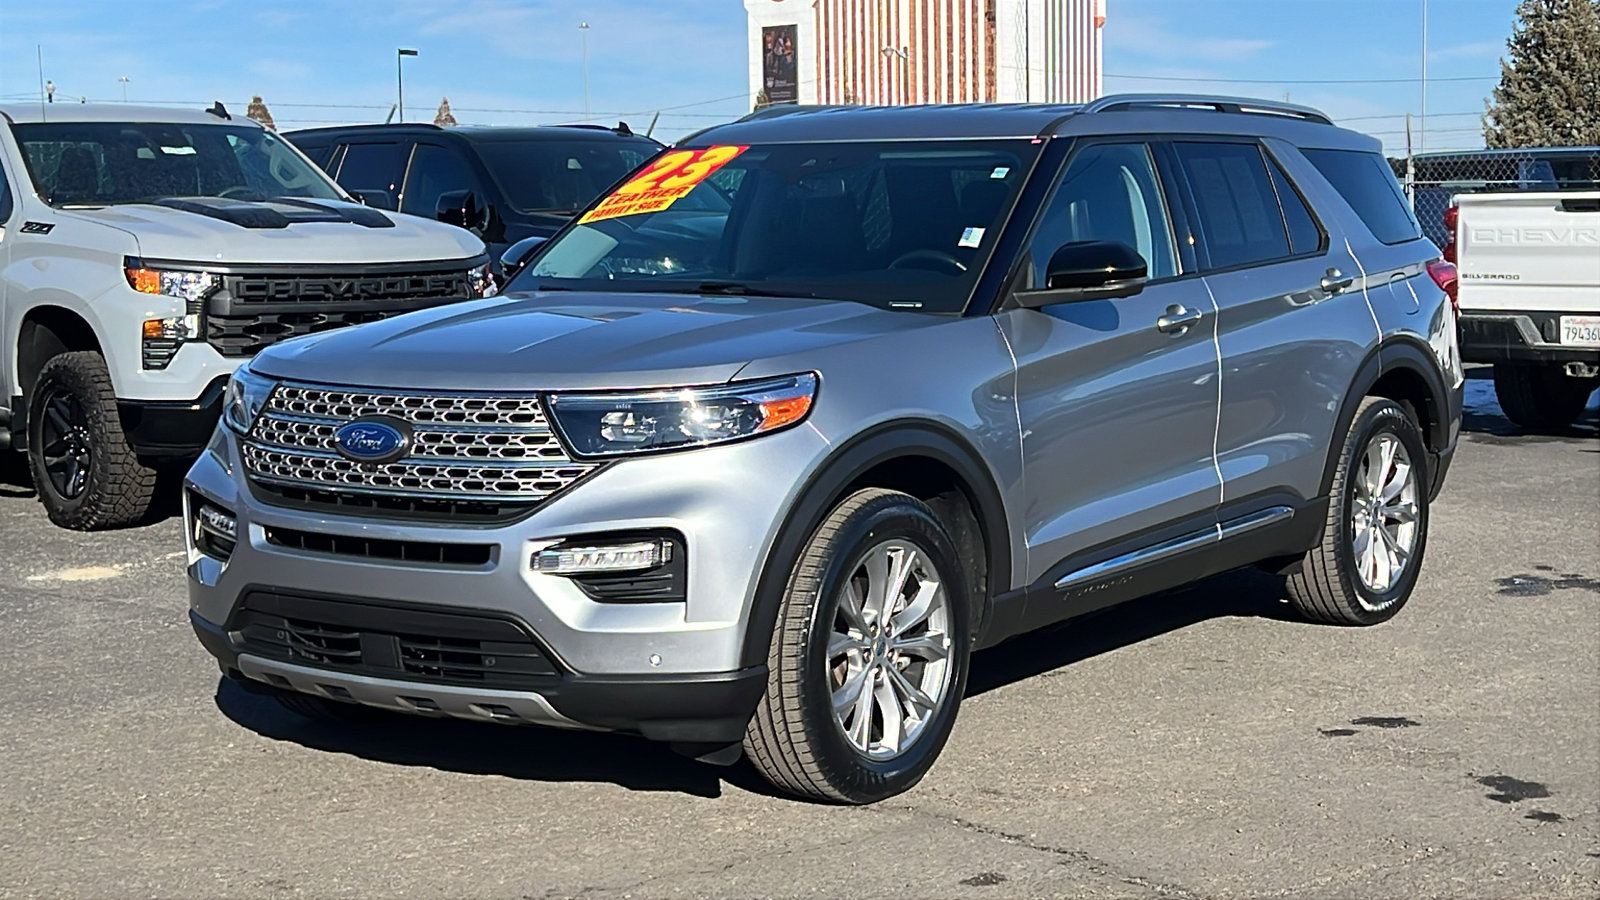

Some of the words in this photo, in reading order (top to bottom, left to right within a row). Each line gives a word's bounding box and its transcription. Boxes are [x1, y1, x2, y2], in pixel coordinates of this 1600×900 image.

[617, 146, 740, 194] 23
[602, 185, 690, 207] LEATHER
[586, 204, 635, 220] FAMILY
[633, 199, 669, 211] SIZE
[236, 276, 463, 300] CHEVROLET
[1461, 273, 1520, 281] SILVERADO
[346, 428, 386, 451] Ford
